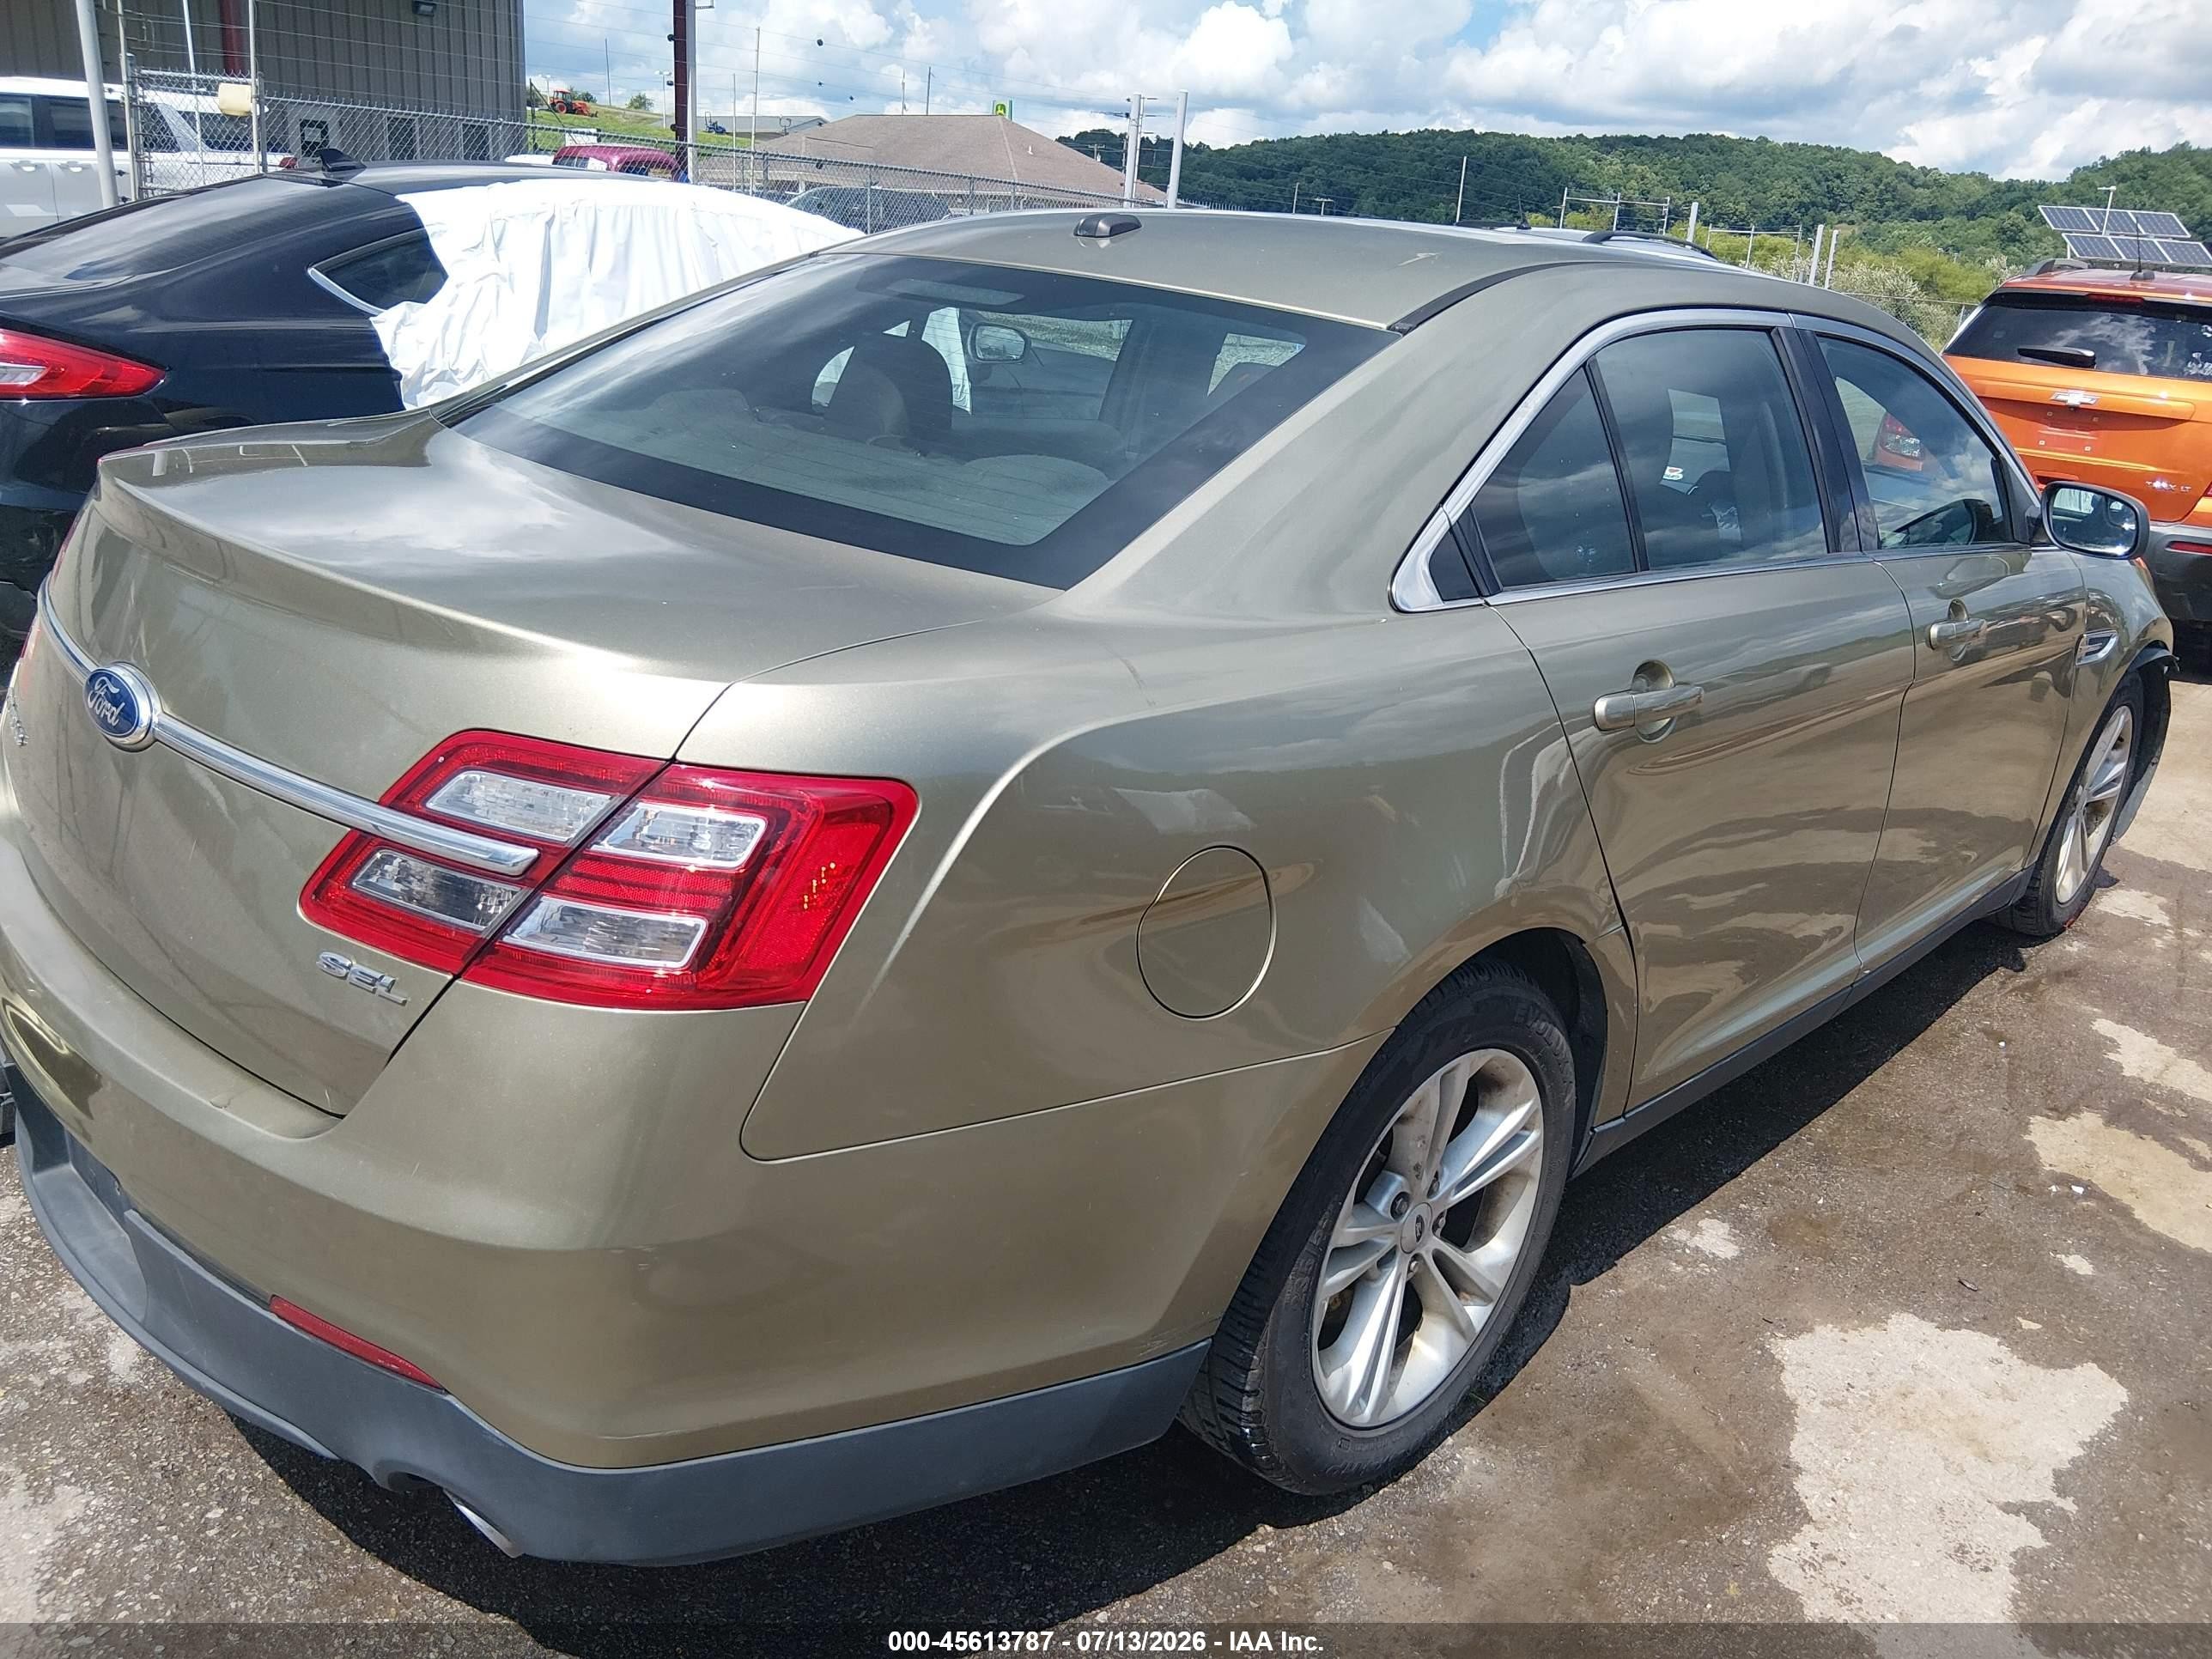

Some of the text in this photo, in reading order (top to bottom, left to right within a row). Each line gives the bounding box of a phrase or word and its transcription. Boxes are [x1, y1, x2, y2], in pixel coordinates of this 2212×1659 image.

[2145, 480, 2177, 491] TX
[87, 675, 125, 727] Ford
[315, 951, 410, 1007] SEL
